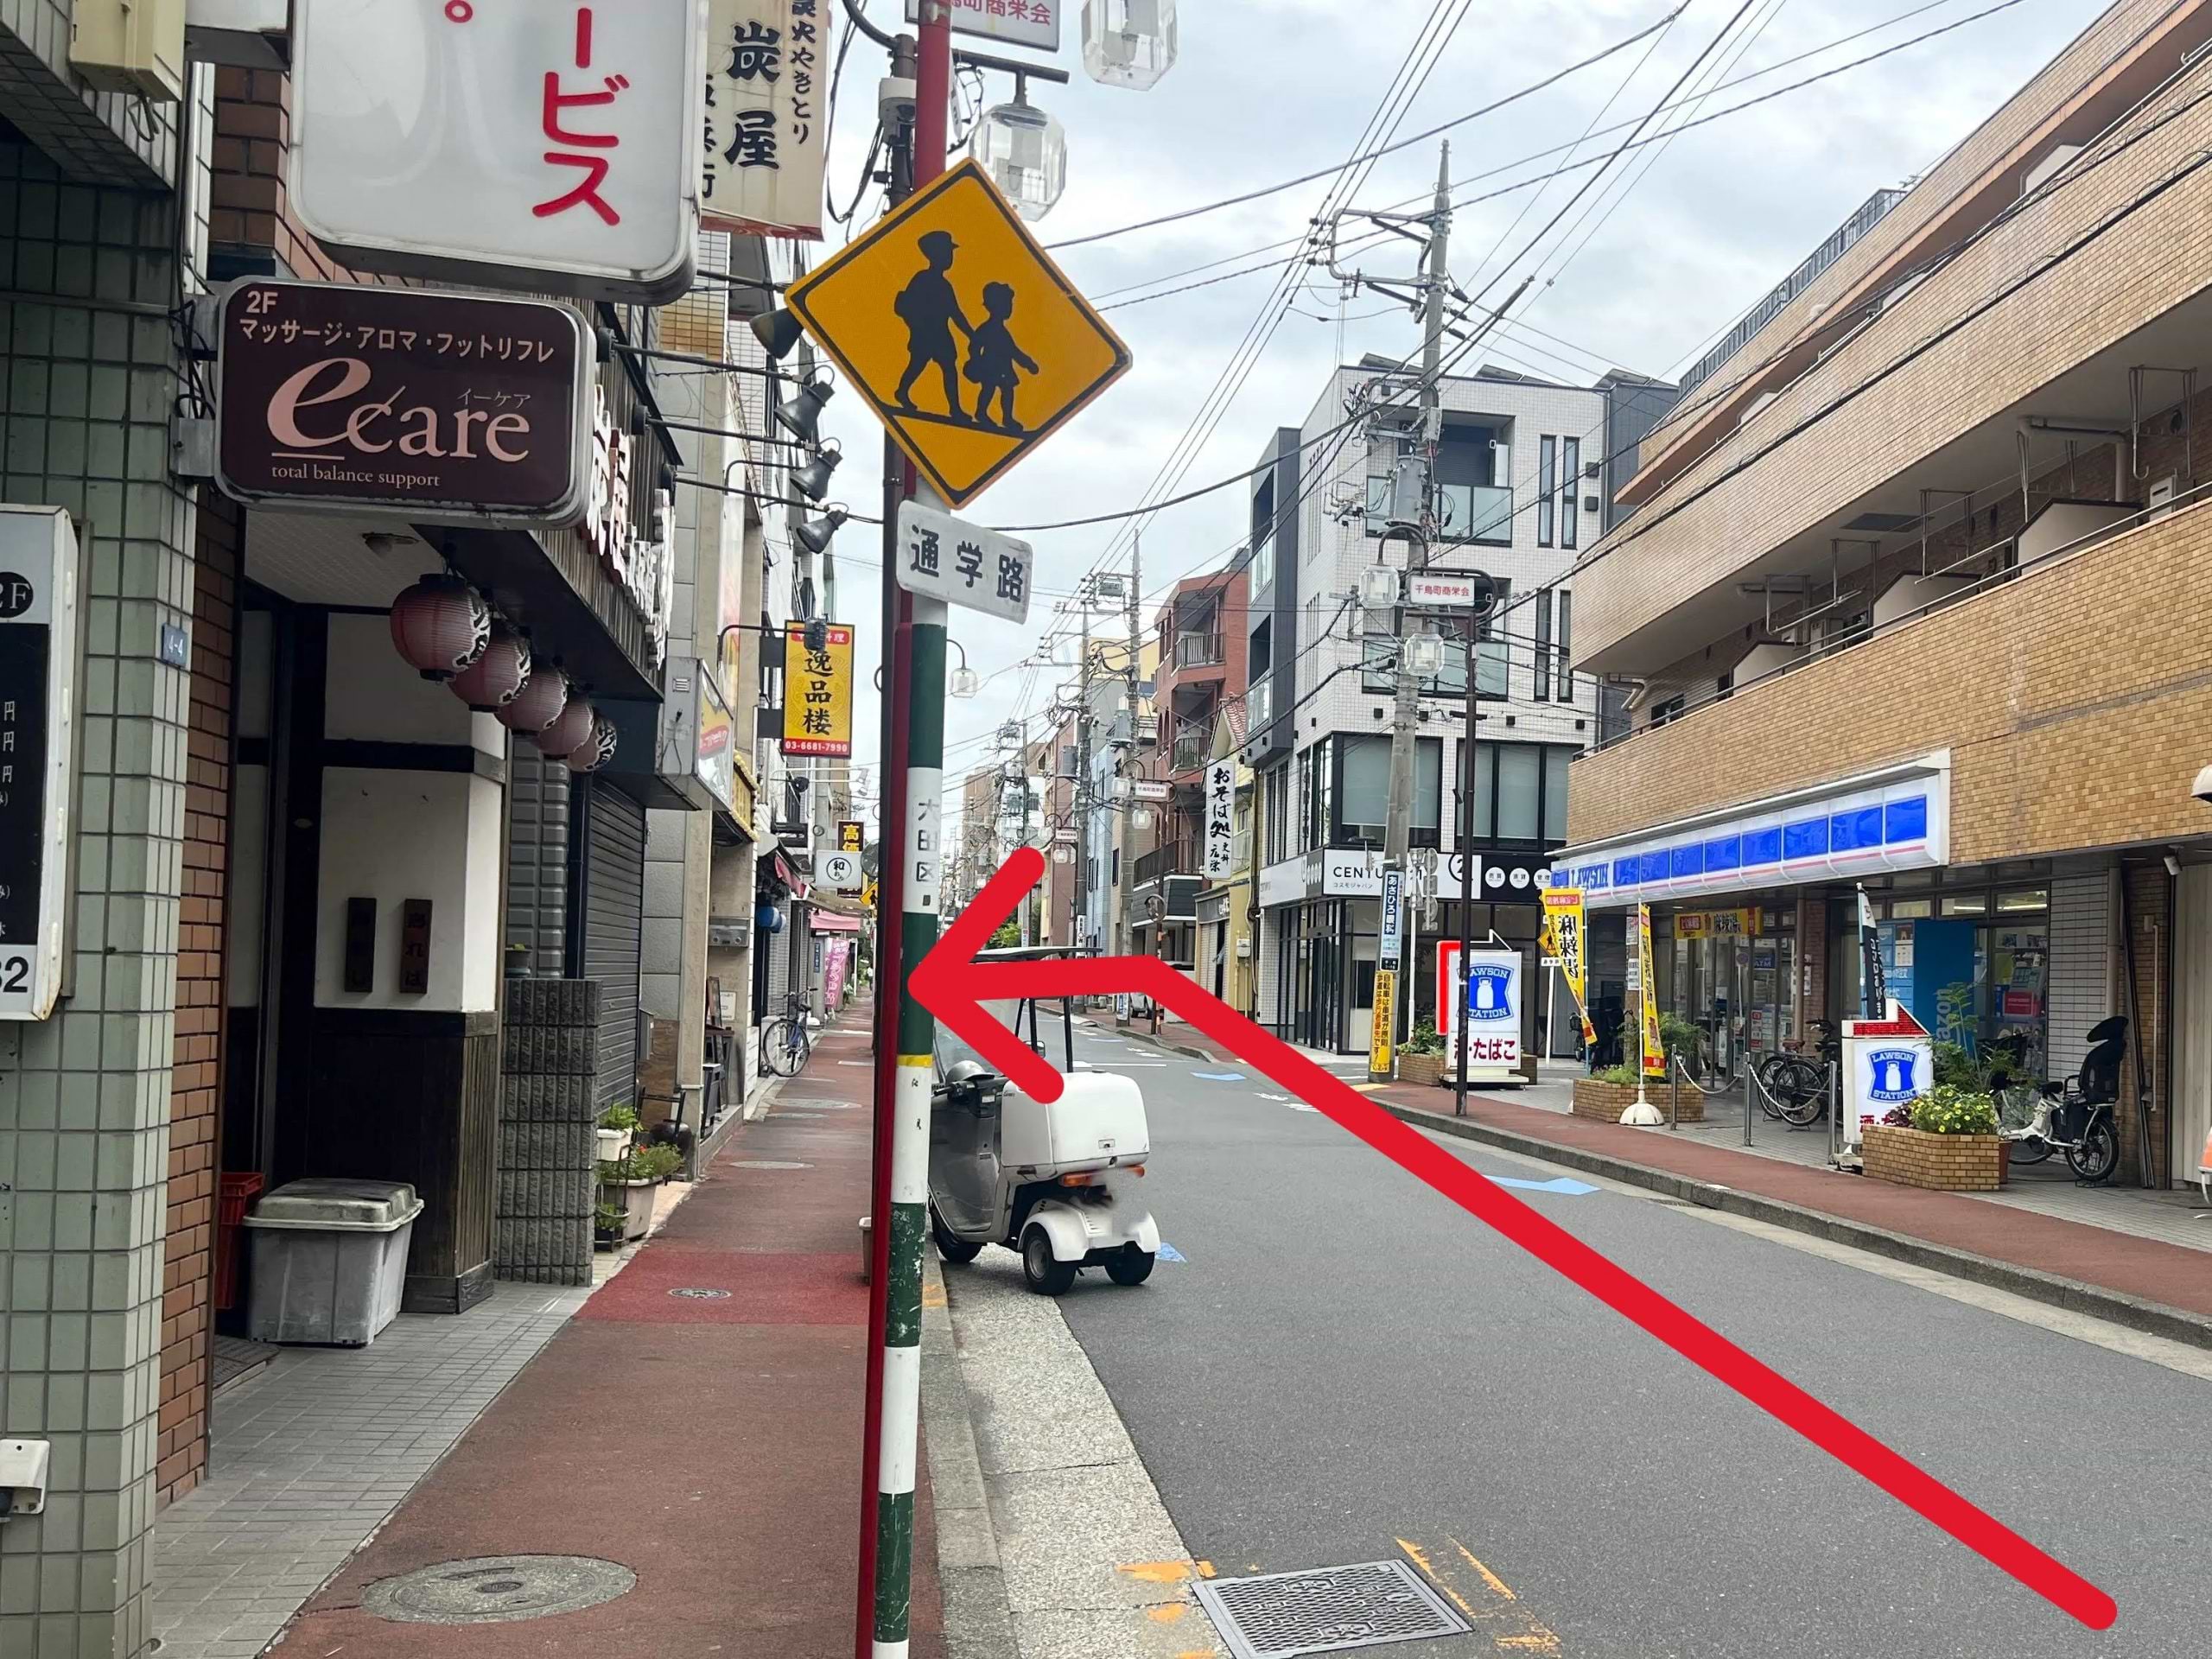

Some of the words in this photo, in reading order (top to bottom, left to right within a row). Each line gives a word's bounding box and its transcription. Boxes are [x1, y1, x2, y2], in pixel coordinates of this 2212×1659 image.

[724, 22, 781, 169] 炭屋
[247, 290, 278, 315] 2F
[457, 387, 532, 409] イーケア
[271, 463, 308, 480] total
[313, 464, 373, 484] balance
[378, 470, 442, 490] support
[910, 524, 1023, 603] 通学路
[168, 634, 183, 658] 4-4
[785, 740, 849, 753] 03-6681-7990
[1461, 967, 1510, 979] AWSON
[1461, 1007, 1508, 1018] TATION
[1872, 1052, 1916, 1063] LAWSON
[1872, 1088, 1916, 1100] STATION
